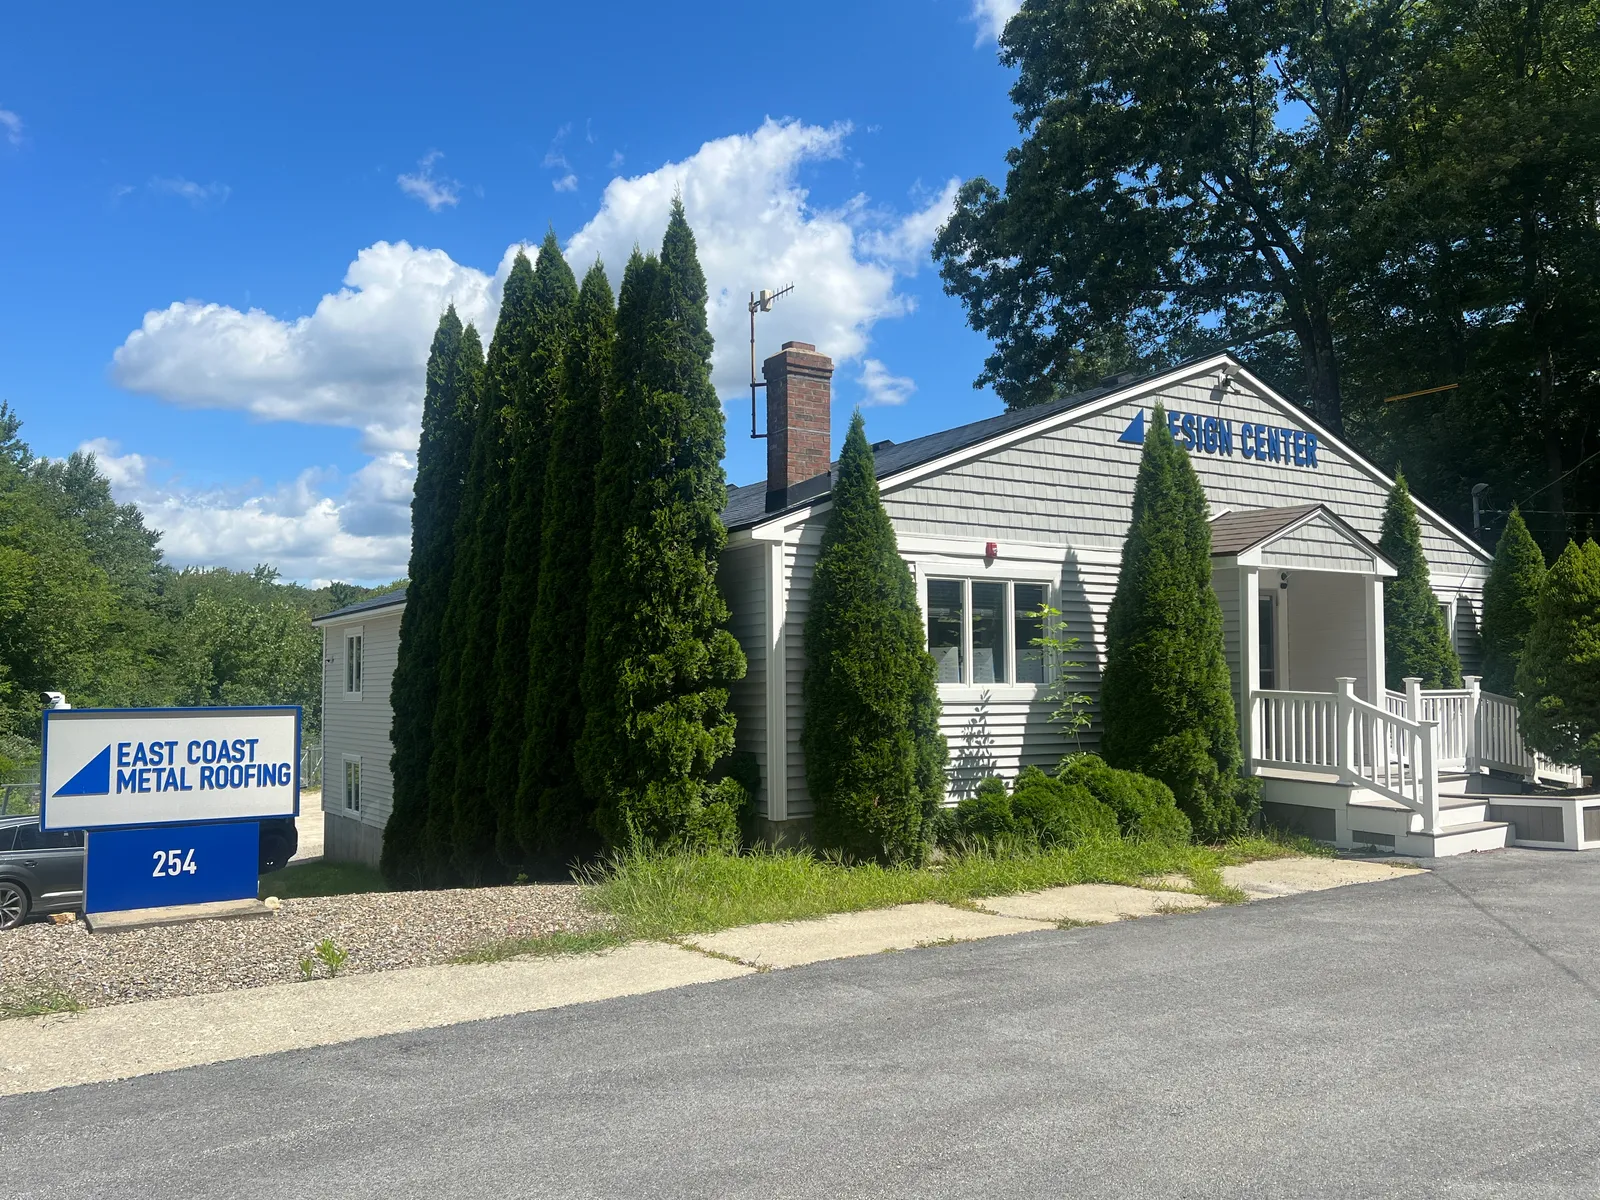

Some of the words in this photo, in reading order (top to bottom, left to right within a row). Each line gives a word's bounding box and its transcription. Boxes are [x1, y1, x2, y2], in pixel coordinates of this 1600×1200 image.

[1168, 410, 1233, 457] ESIGN
[1241, 422, 1318, 468] CENTER
[117, 741, 178, 767] EAST
[187, 738, 259, 764] COAST
[116, 766, 192, 794] METAL
[200, 763, 291, 790] ROOFING
[152, 849, 197, 877] 254
